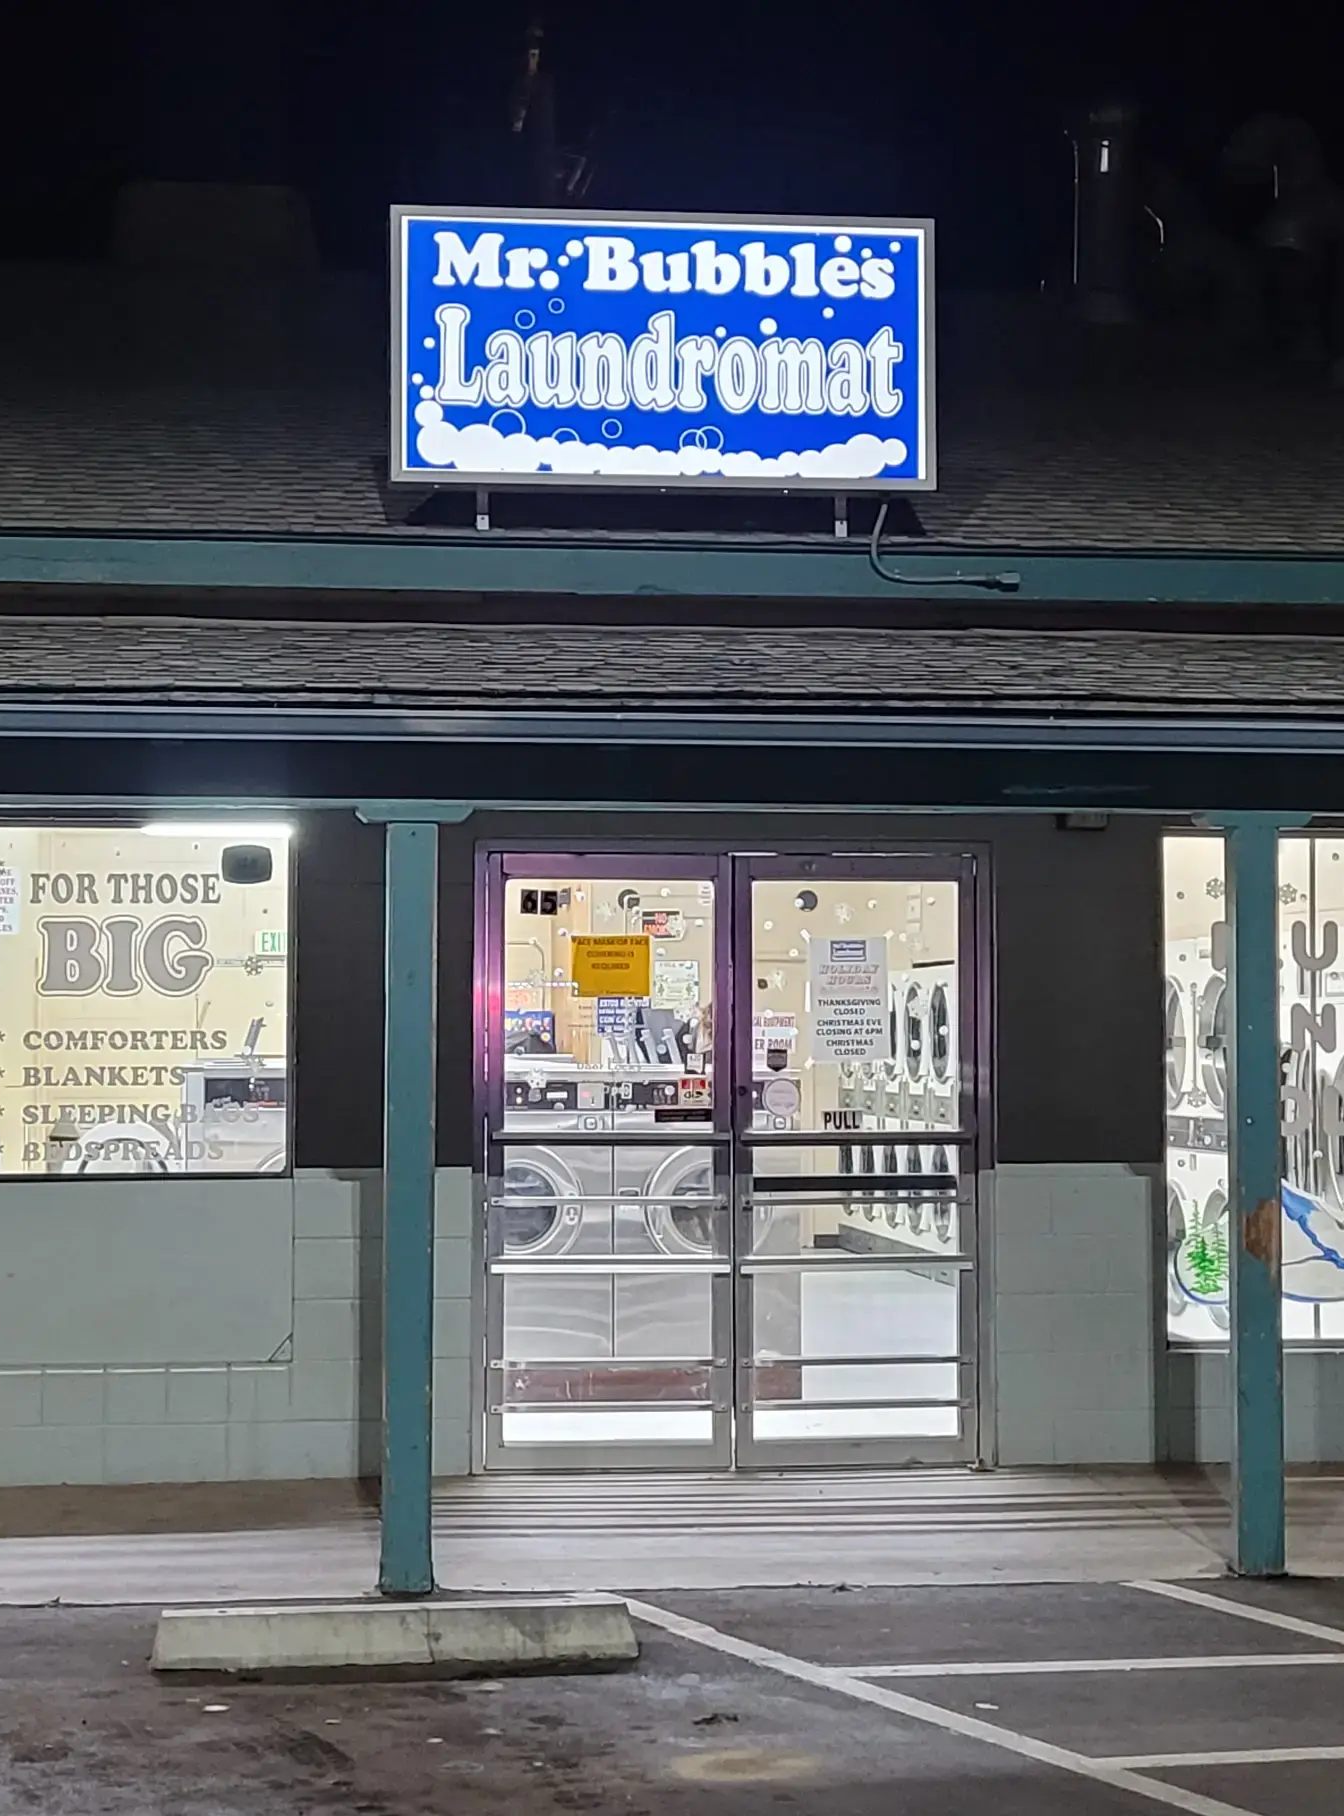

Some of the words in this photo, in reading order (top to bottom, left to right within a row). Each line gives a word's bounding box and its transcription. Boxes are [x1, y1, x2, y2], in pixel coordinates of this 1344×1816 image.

[432, 231, 559, 290] Mr.
[583, 235, 896, 300] Bubbles
[434, 302, 904, 417] Laundromat
[29, 873, 99, 904] FOR
[107, 873, 221, 904] THOSE
[36, 914, 213, 997] BIG
[23, 1030, 227, 1050] COMFORTERS
[816, 1028, 852, 1036] CLOSING
[826, 1039, 874, 1047] CHRISTMAS
[22, 1066, 186, 1086] BLANKETS
[22, 1104, 171, 1124] SLEEPING
[181, 1102, 259, 1124] BAGS
[824, 1111, 860, 1131] PULL
[22, 1141, 224, 1162] BEDSPREADS
